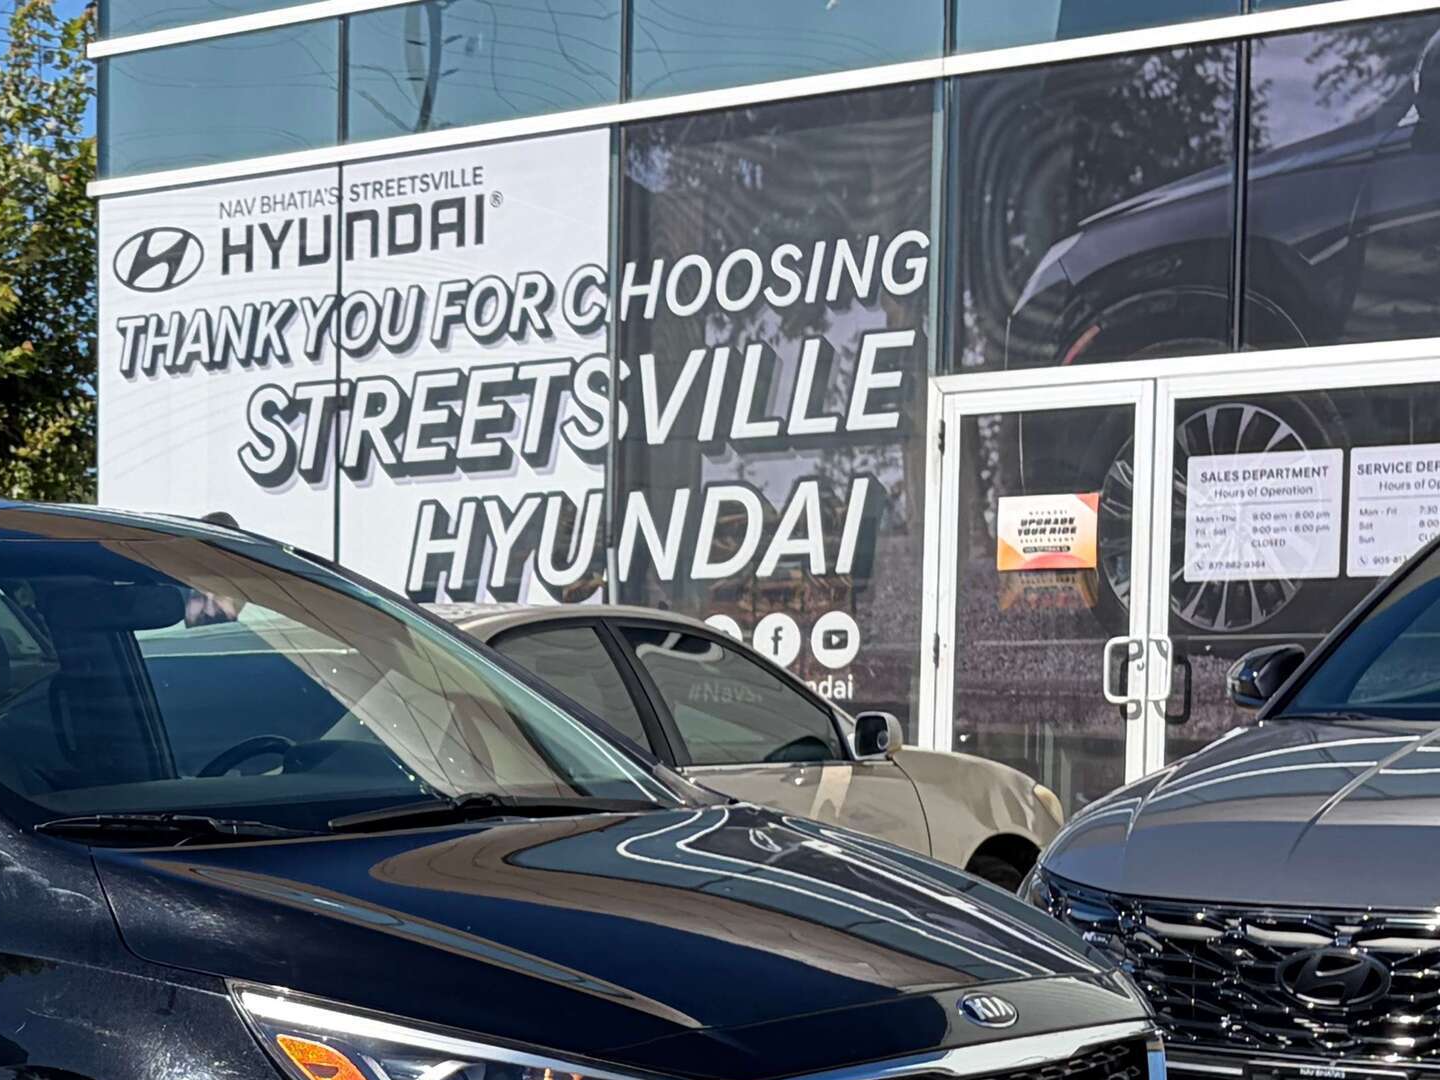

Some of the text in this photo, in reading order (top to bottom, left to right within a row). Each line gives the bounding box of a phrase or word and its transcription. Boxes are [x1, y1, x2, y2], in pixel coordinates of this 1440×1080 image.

[219, 166, 484, 219] NAV BHATIA'S STREETSVILLE
[221, 194, 485, 275] HYUNDAI
[117, 230, 930, 378] THANK YOU FOR CHOOSING
[238, 329, 922, 488] STREETSVILLE
[1200, 466, 1329, 483] SALES DEPARTMENT
[1214, 485, 1313, 499] Hours of Operation
[1357, 461, 1412, 476] SERVICE
[1380, 481, 1411, 491] Hours
[1415, 479, 1425, 489] of
[405, 475, 878, 602] HYUNDAI
